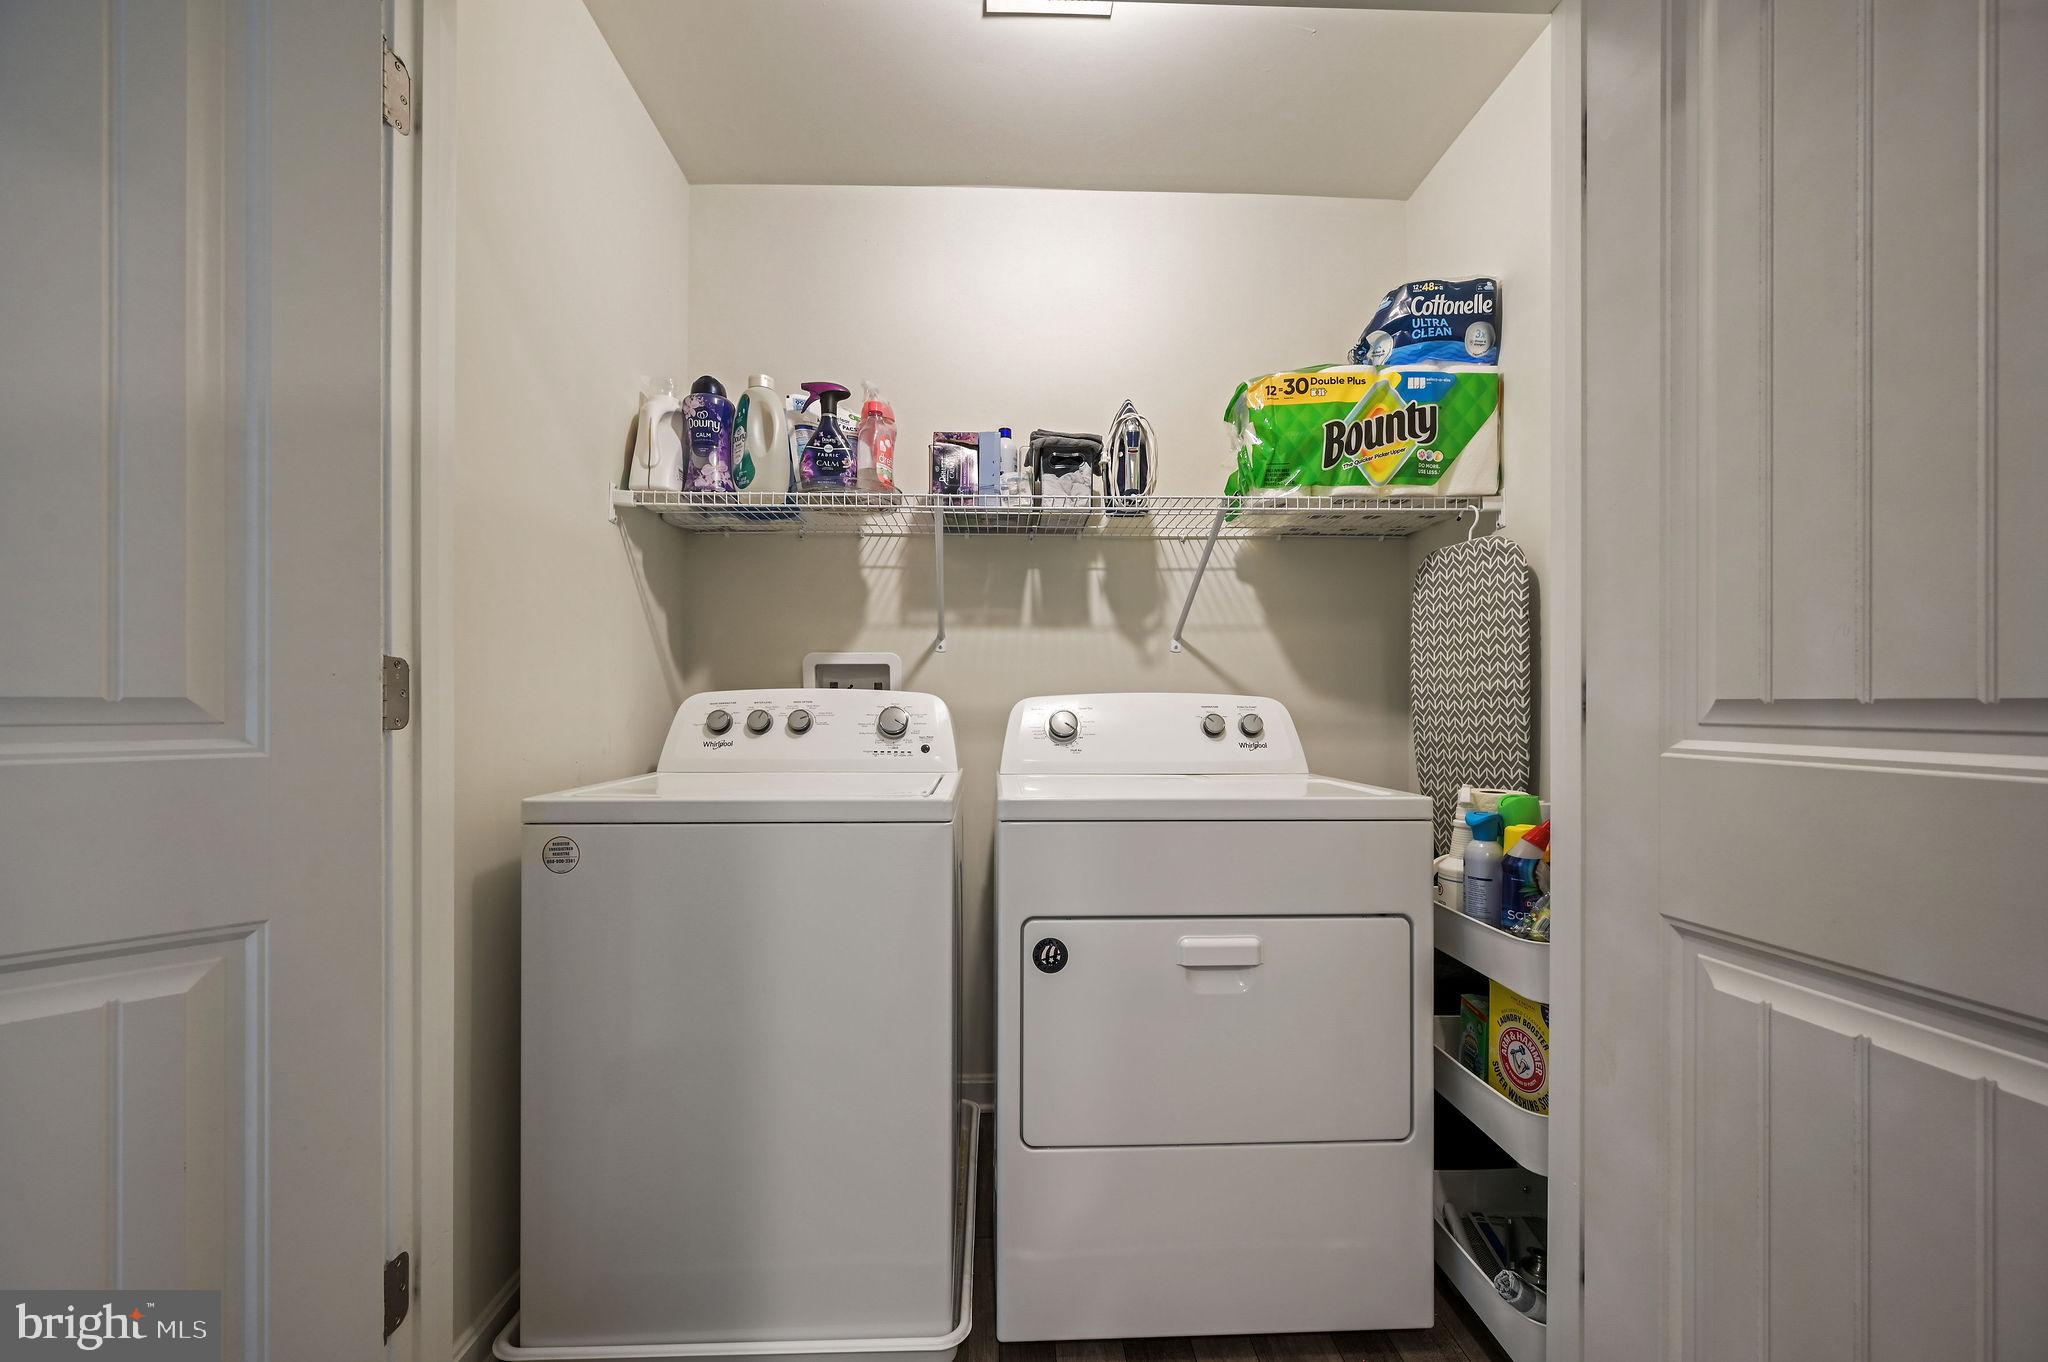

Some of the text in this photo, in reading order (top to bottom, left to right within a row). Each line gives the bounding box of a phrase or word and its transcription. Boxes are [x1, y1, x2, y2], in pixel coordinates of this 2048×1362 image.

[1422, 282, 1435, 291] 48
[1411, 293, 1493, 316] Cottonelle
[1412, 318, 1448, 328] ULTRA
[1412, 327, 1452, 339] CLEAN
[1265, 385, 1277, 396] 12
[1283, 377, 1309, 395] 30
[1310, 376, 1345, 386] Double
[1347, 376, 1366, 385] Plus
[688, 417, 721, 433] Downy
[1323, 400, 1439, 470] Bounty
[816, 459, 840, 467] CALM
[1342, 447, 1407, 470] The Quicker Picker Upper
[703, 739, 734, 750] Whirlpool
[1238, 740, 1268, 751] Whirlpool
[1497, 1013, 1549, 1051] LAUNDRY BOOSTER
[1492, 1060, 1508, 1090] SUPER
[1508, 1085, 1540, 1112] WASHING
